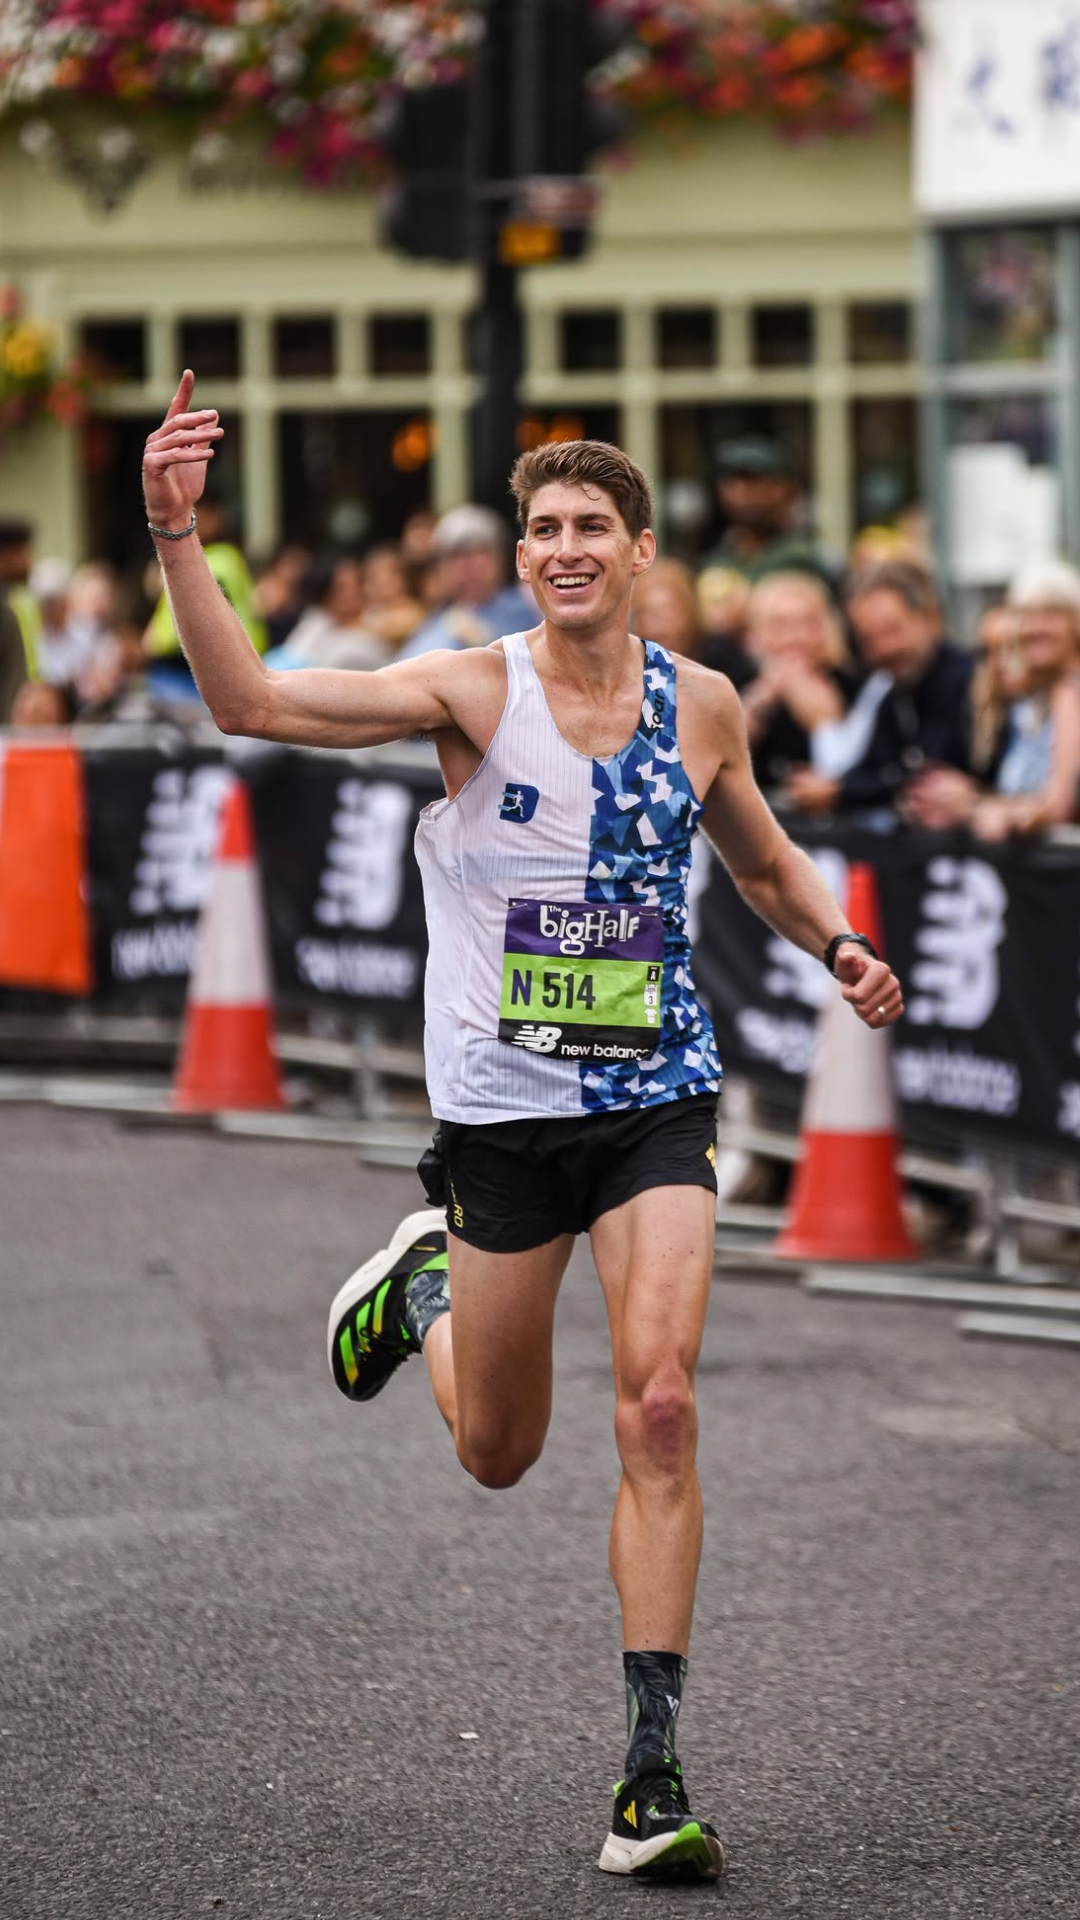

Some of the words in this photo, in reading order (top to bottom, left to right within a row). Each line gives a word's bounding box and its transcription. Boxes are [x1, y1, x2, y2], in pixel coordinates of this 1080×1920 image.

[511, 969, 532, 1006] N
[542, 972, 596, 1011] 514
[561, 1044, 592, 1056] new
